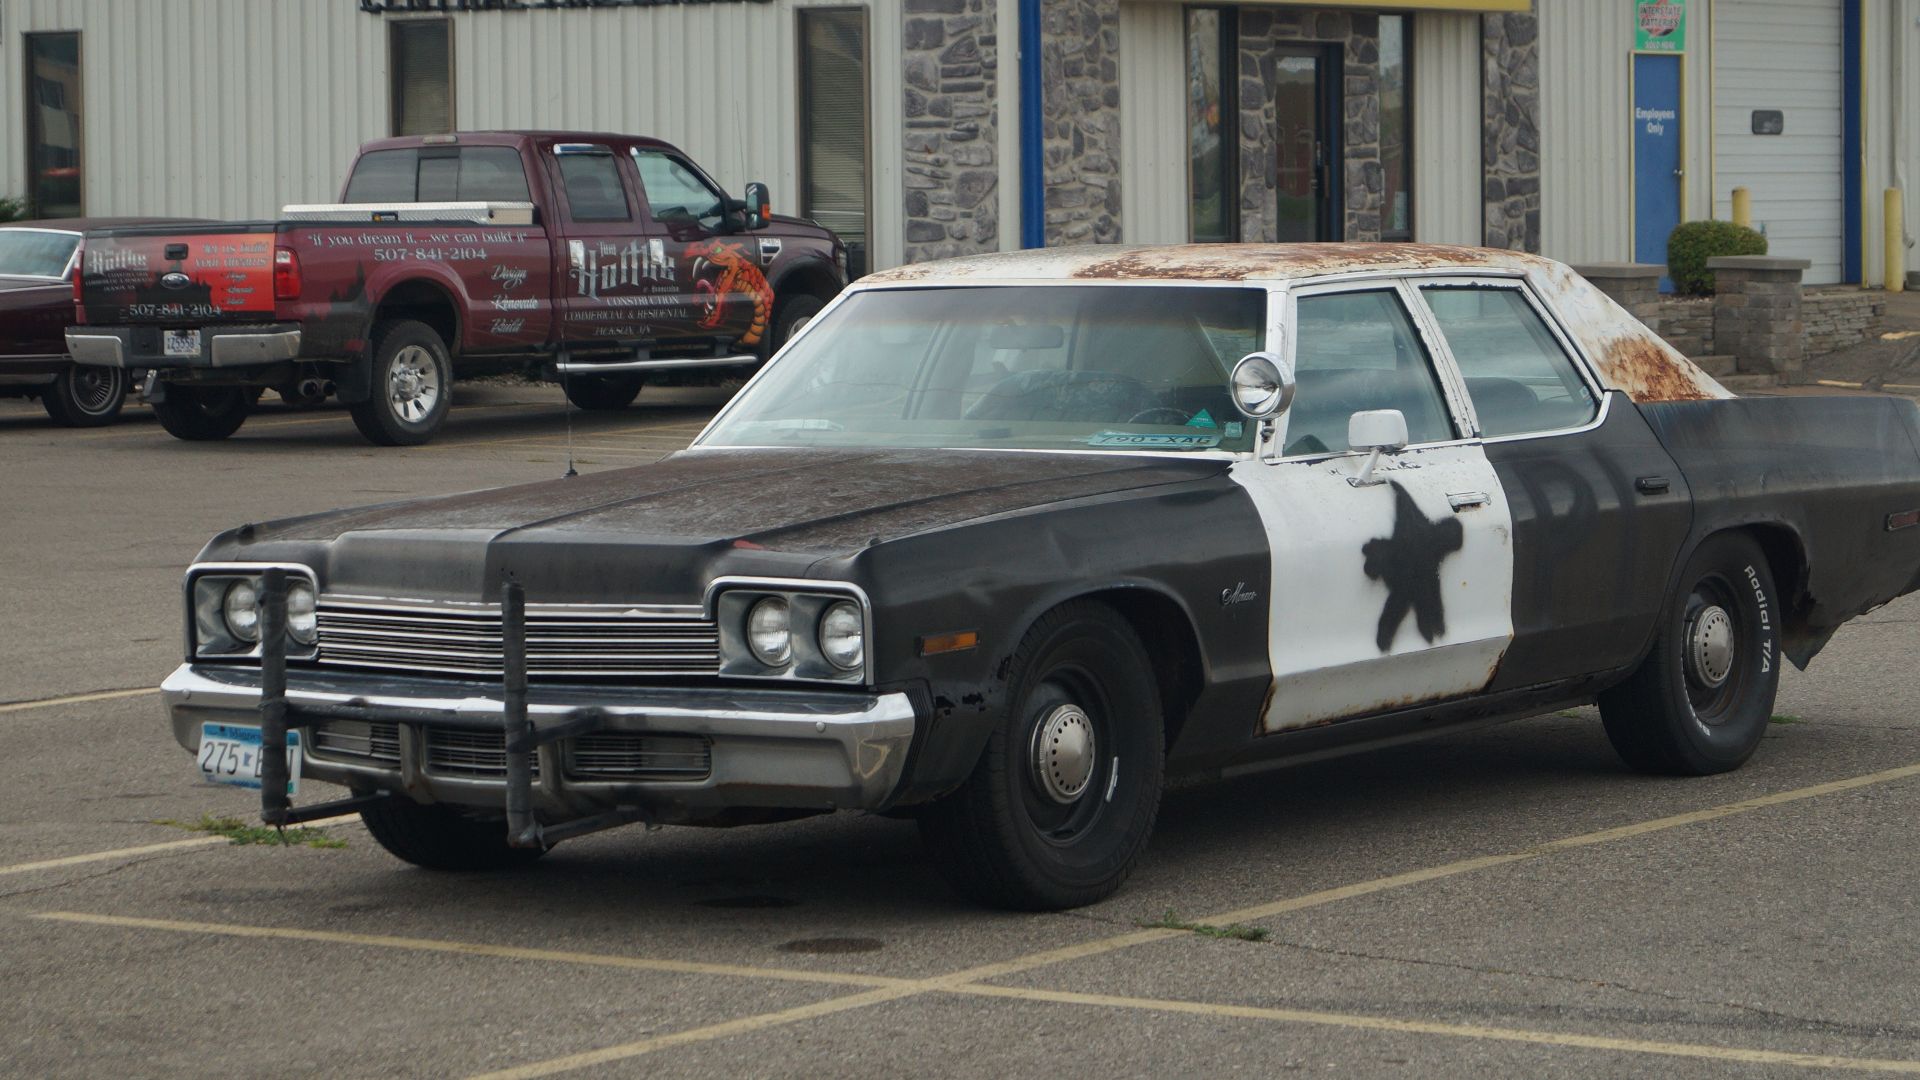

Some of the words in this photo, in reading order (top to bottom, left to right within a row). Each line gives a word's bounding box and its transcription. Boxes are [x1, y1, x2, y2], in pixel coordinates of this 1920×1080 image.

[1636, 107, 1675, 120] Employees
[1647, 122, 1664, 135] Only
[328, 235, 353, 247] you
[358, 232, 401, 245] dream
[454, 233, 478, 243] can
[482, 232, 512, 243] build
[374, 248, 487, 260] 507-841-2104
[490, 264, 528, 289] Design
[606, 296, 680, 306] CONSTRUCTION
[129, 303, 222, 317] 507-841-2104
[1744, 565, 1771, 630] Radial
[1761, 639, 1772, 673] T/A
[202, 741, 241, 775] 275
